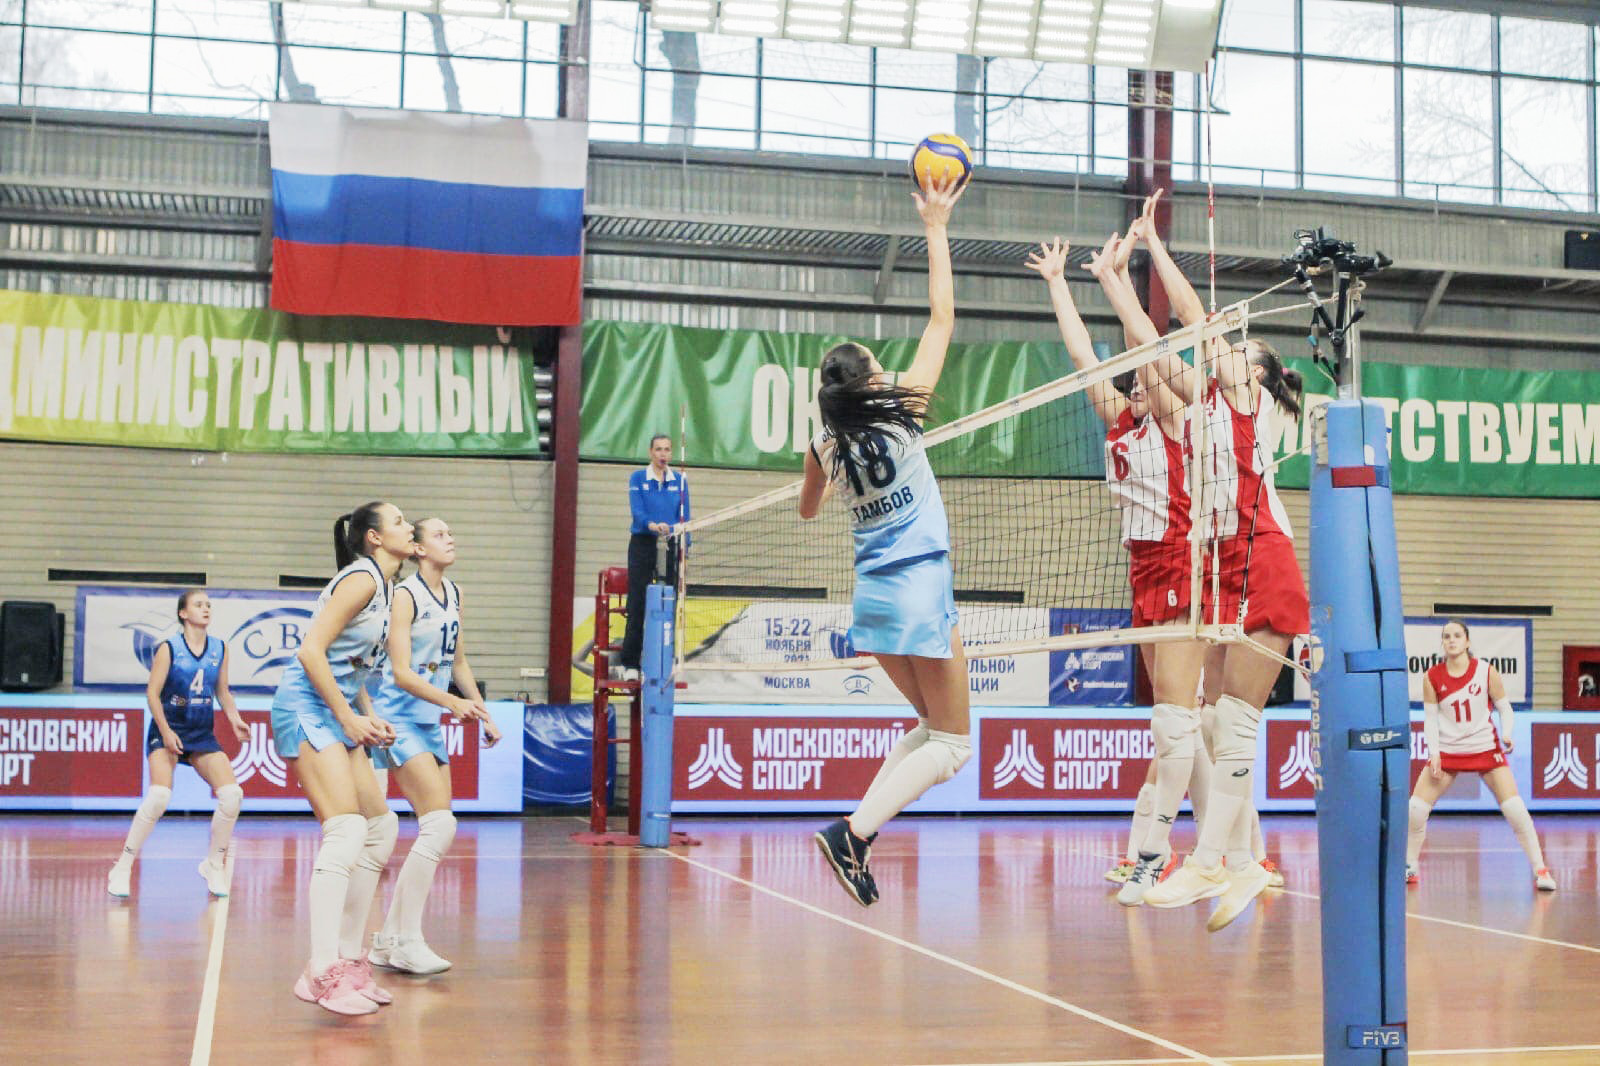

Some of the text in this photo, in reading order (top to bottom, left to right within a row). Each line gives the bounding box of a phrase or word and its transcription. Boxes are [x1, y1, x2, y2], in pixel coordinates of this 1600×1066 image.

[1111, 442, 1129, 480] 6
[852, 486, 914, 523] ТАМБОВ
[440, 620, 459, 657] 13
[765, 618, 811, 636] 15-22
[765, 639, 811, 651] НОЯБРЯ
[190, 668, 204, 695] 4
[764, 676, 811, 689] МОСКВА
[1451, 698, 1472, 723] 11
[1054, 729, 1155, 760] МОСКОВС
[0, 753, 35, 785] РТ
[752, 760, 825, 790] СПОРТ
[1054, 760, 1122, 790] СПОРТ
